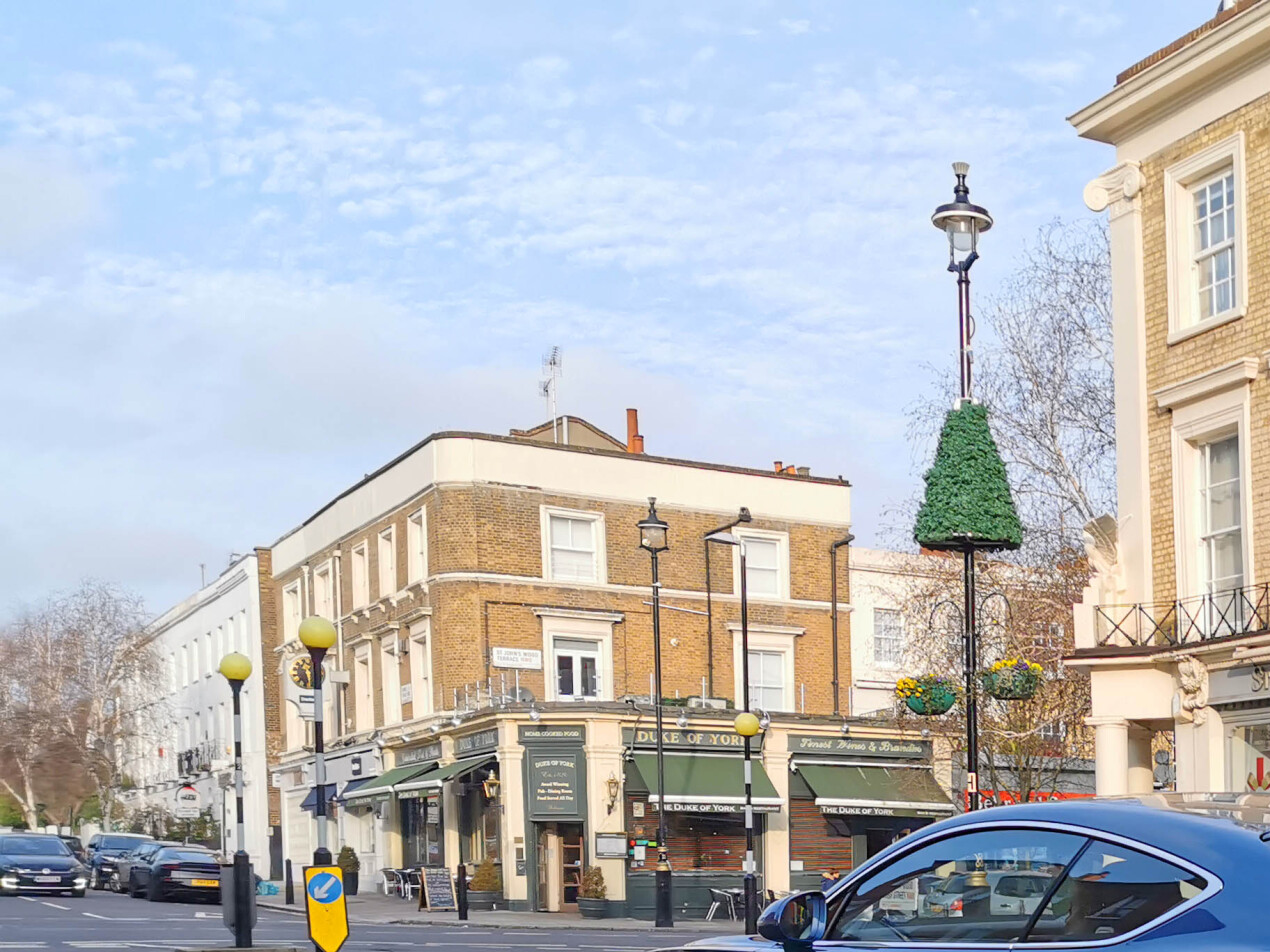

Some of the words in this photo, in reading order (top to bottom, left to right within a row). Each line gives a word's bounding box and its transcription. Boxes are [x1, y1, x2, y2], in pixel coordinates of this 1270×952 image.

[637, 731, 680, 743] DUKE
[687, 733, 704, 744] OF
[800, 737, 832, 749] Finest
[836, 739, 866, 750] Wines
[868, 742, 877, 752] &
[879, 741, 922, 752] Brandies
[559, 760, 575, 768] YORK
[713, 804, 736, 812] YORK
[838, 806, 861, 814] DUKE
[873, 807, 894, 815] YORK
